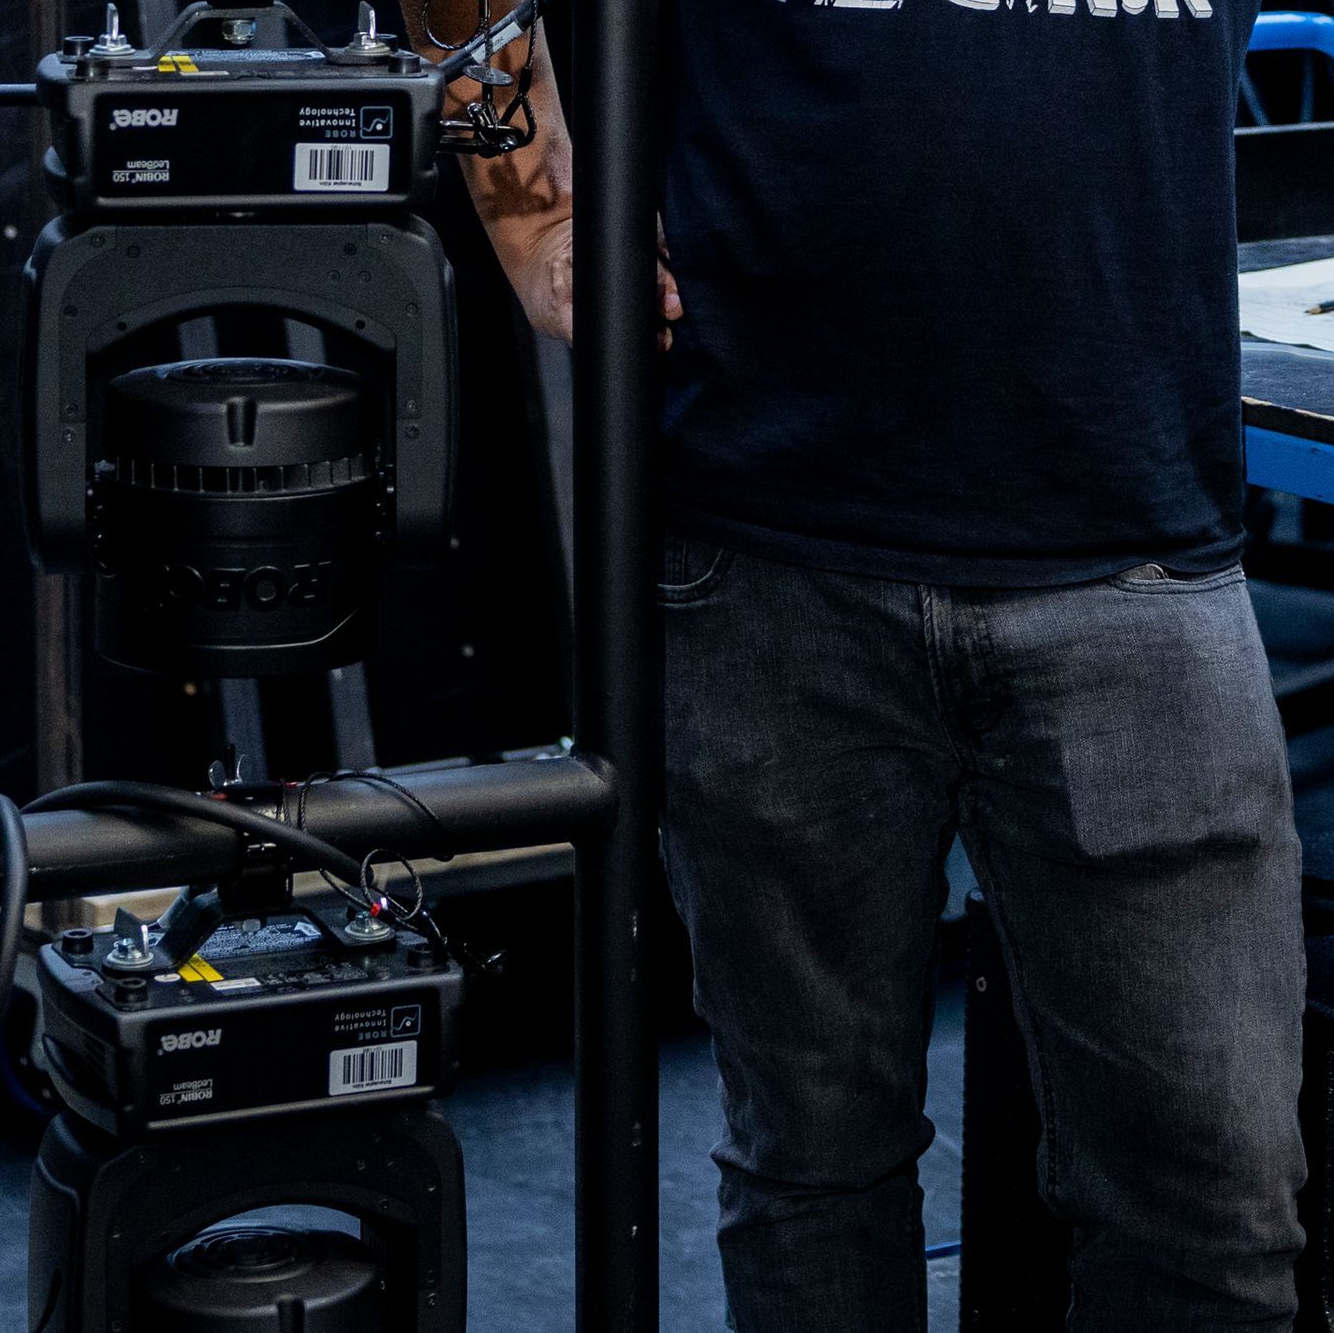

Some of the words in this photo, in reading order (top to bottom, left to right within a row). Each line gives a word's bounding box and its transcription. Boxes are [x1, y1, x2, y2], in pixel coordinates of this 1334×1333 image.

[299, 108, 355, 117] Technology
[299, 119, 355, 128] Innovative
[325, 129, 356, 138] ROBE
[127, 160, 169, 170] LedBeam
[113, 172, 130, 182] 150
[334, 1009, 386, 1021] Technology
[334, 1019, 386, 1032] Innovative
[357, 1030, 386, 1041] ROBE
[173, 1078, 212, 1091] LedBeam
[159, 1094, 176, 1105] 150
